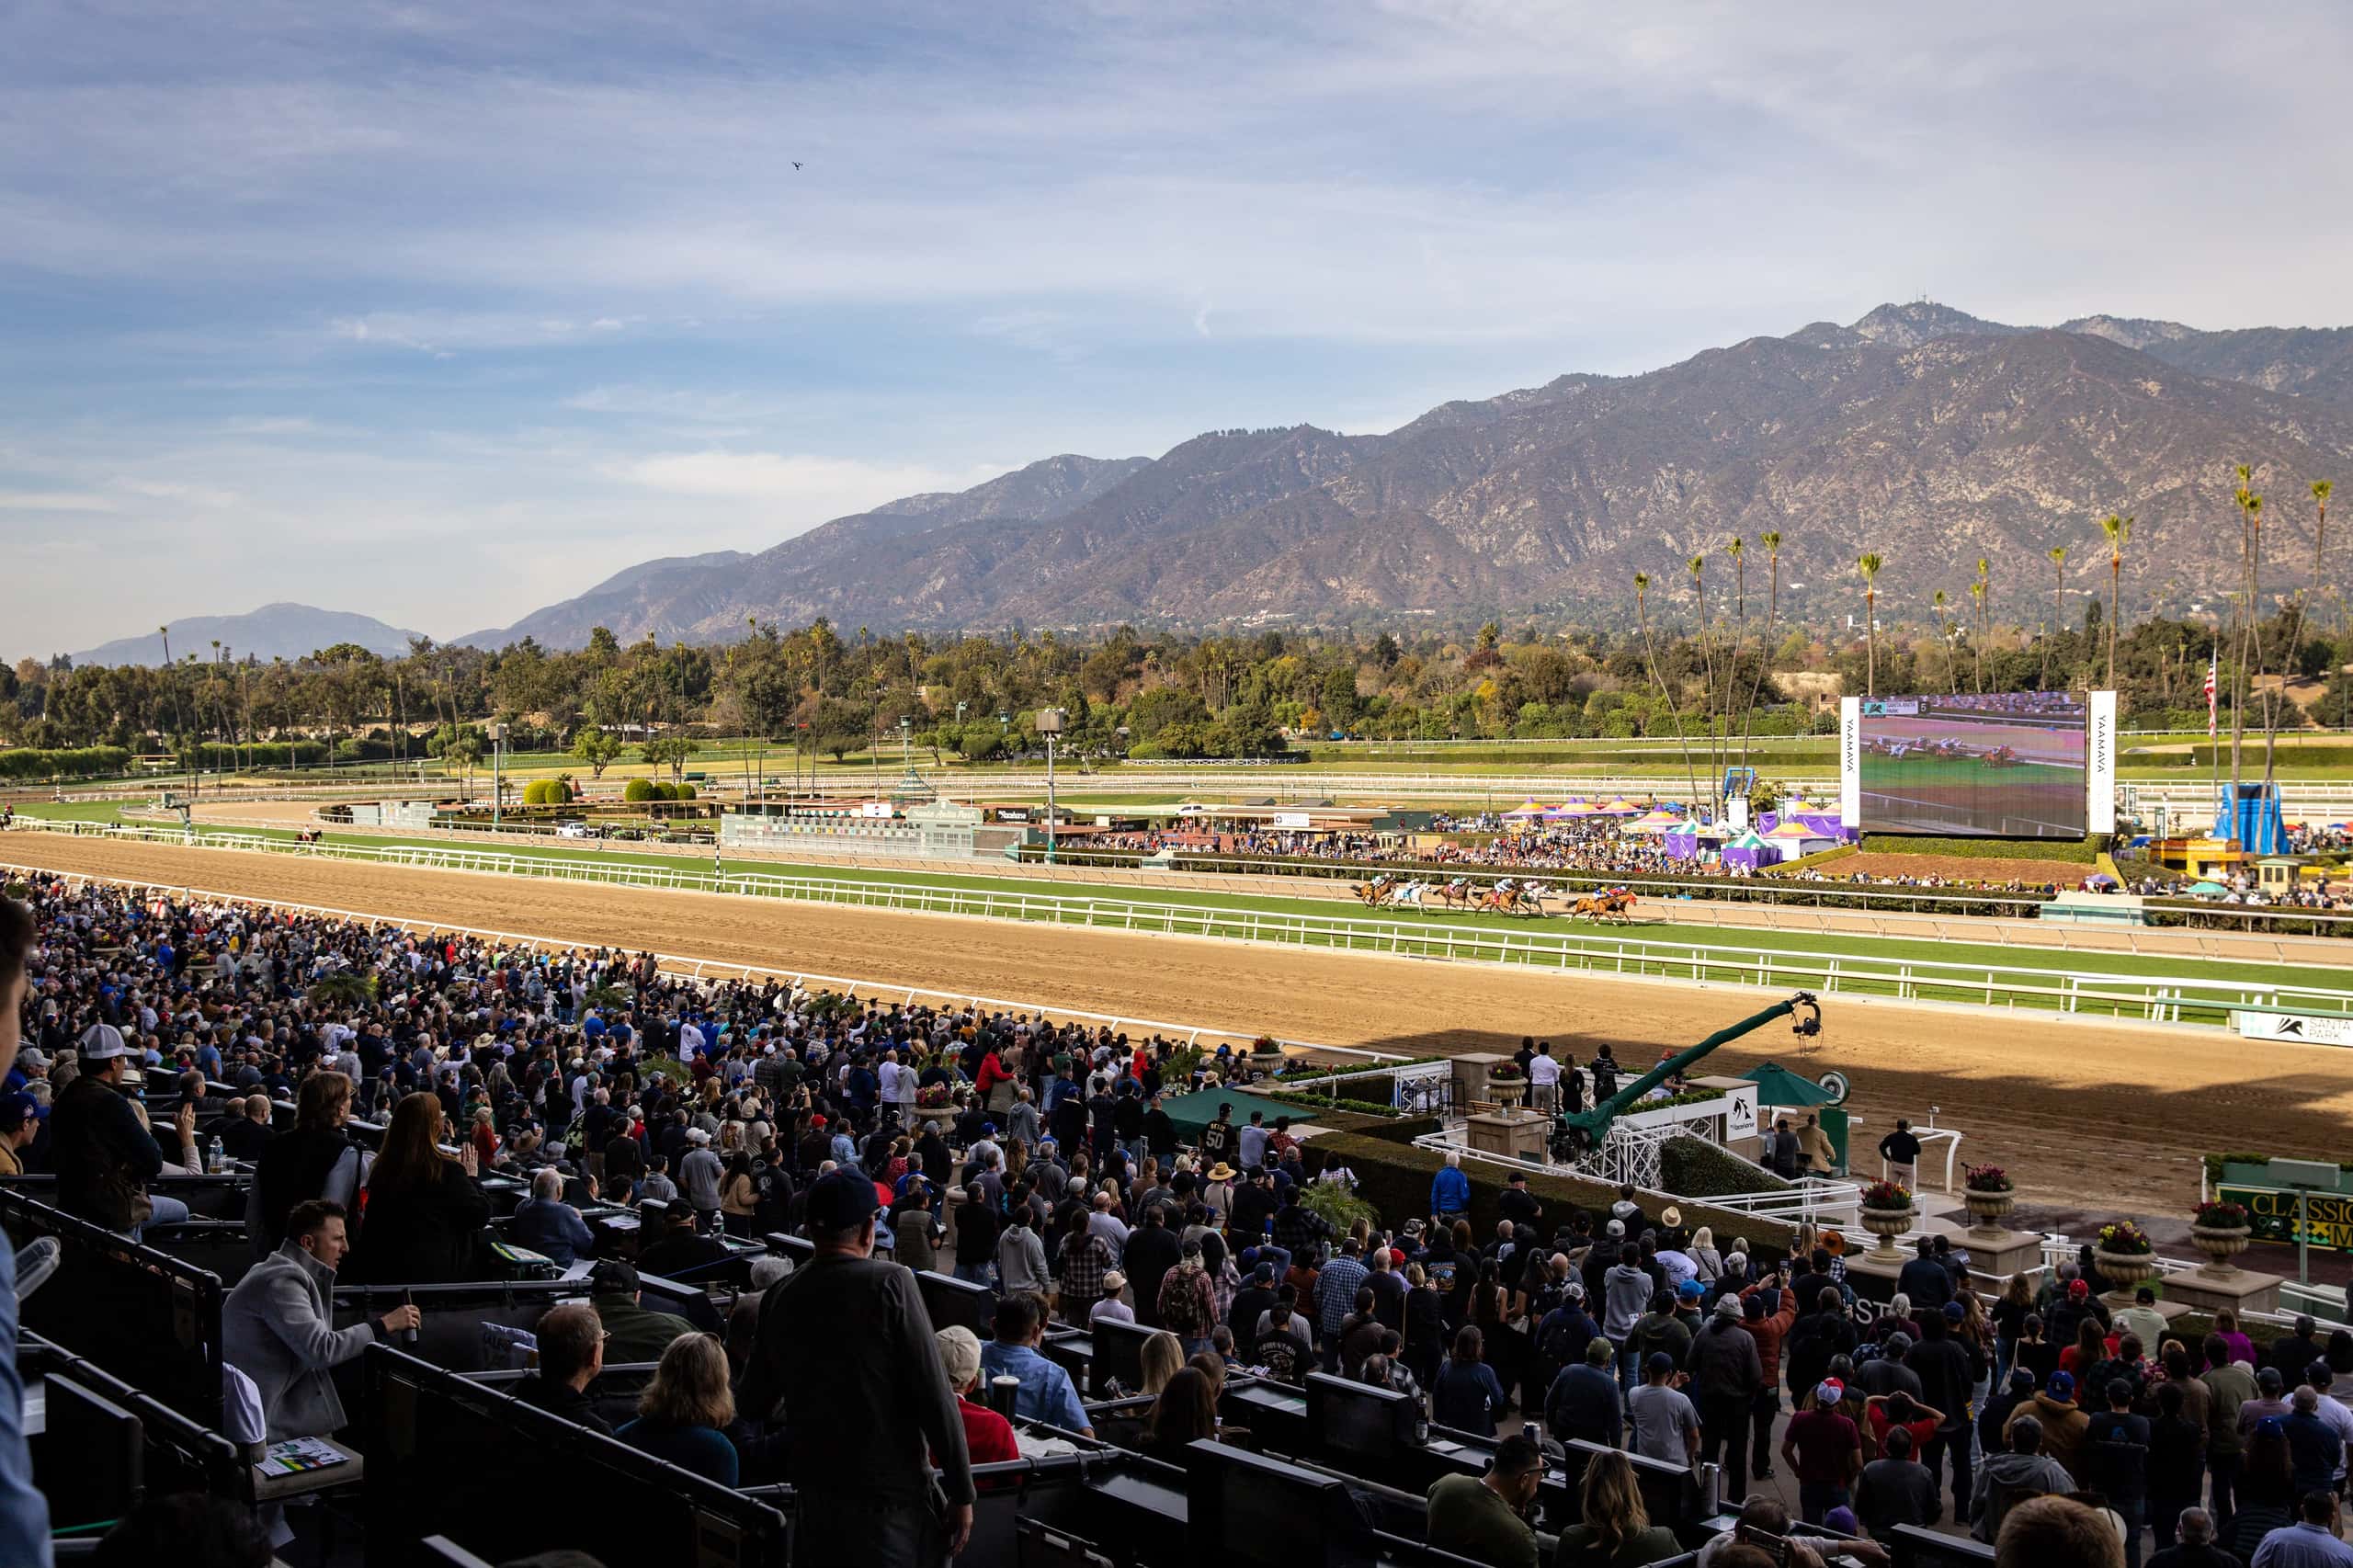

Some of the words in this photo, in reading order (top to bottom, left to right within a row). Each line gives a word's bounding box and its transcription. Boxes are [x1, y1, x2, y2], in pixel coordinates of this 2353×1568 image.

[1920, 703, 1927, 712] 5
[2309, 1017, 2351, 1030] SANTA
[2309, 1029, 2342, 1040] PARK
[1206, 1131, 1224, 1149] 50
